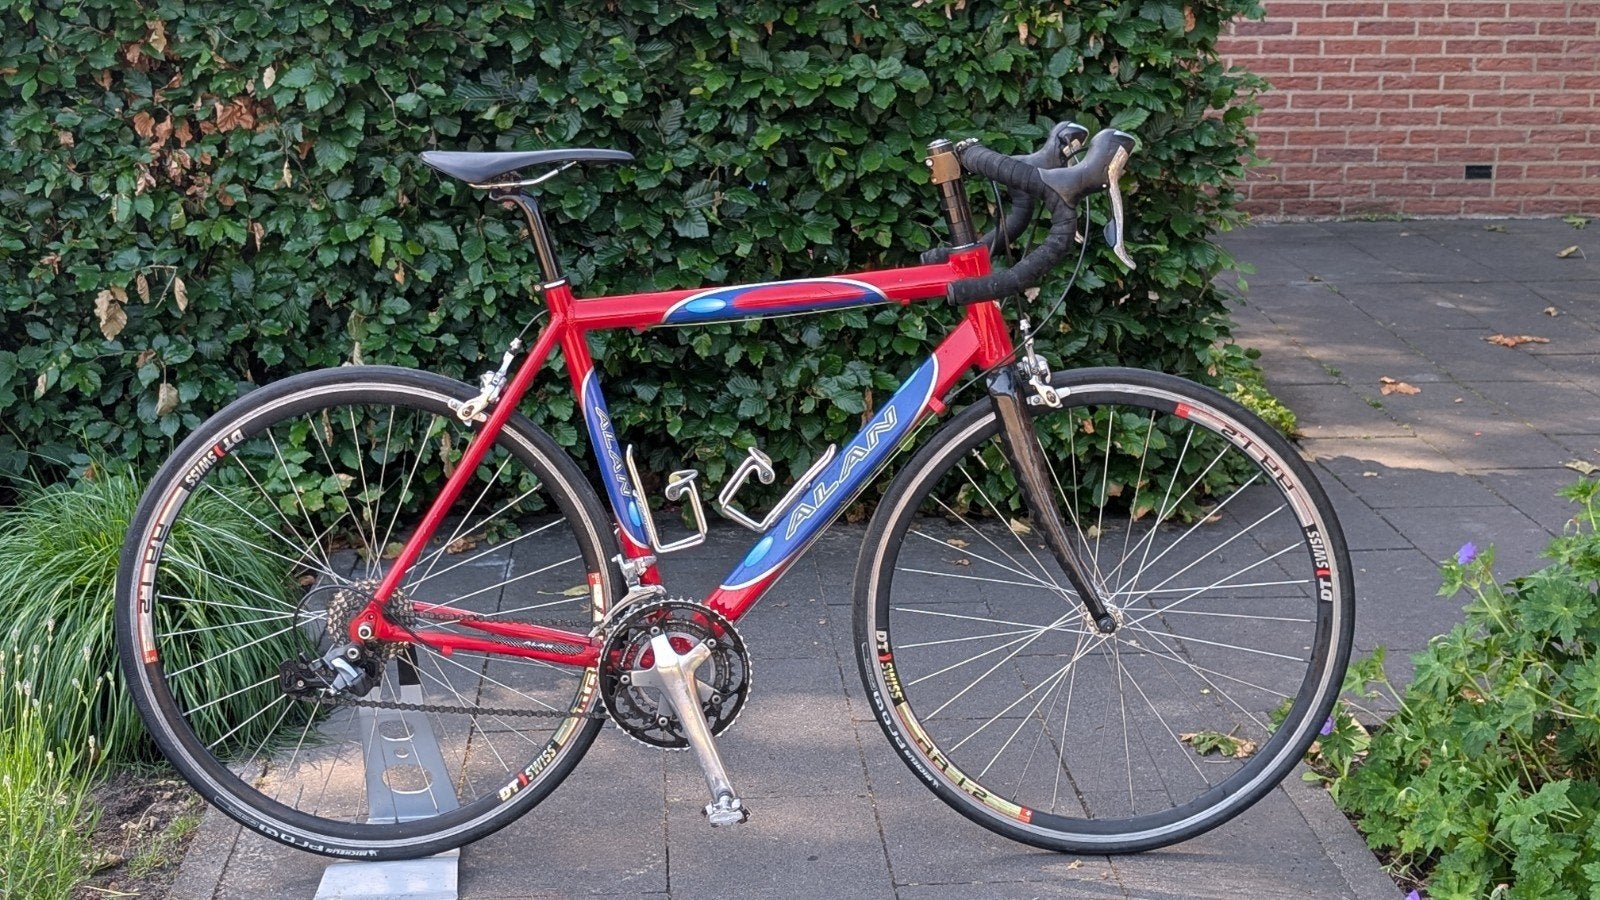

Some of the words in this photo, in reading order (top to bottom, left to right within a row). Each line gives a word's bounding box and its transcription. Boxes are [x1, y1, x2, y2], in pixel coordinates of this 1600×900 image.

[223, 428, 245, 452] DT
[595, 406, 633, 497] ALAN
[185, 450, 218, 487] SWISS
[785, 405, 898, 540] ALAN
[1307, 530, 1329, 569] SWISS
[1320, 577, 1332, 602] DT
[523, 640, 554, 649] ALAN
[876, 630, 889, 653] DT
[881, 662, 903, 700] SWISS
[499, 779, 519, 801] DT
[525, 744, 557, 781] SWISS
[904, 750, 935, 784] MICHELIN
